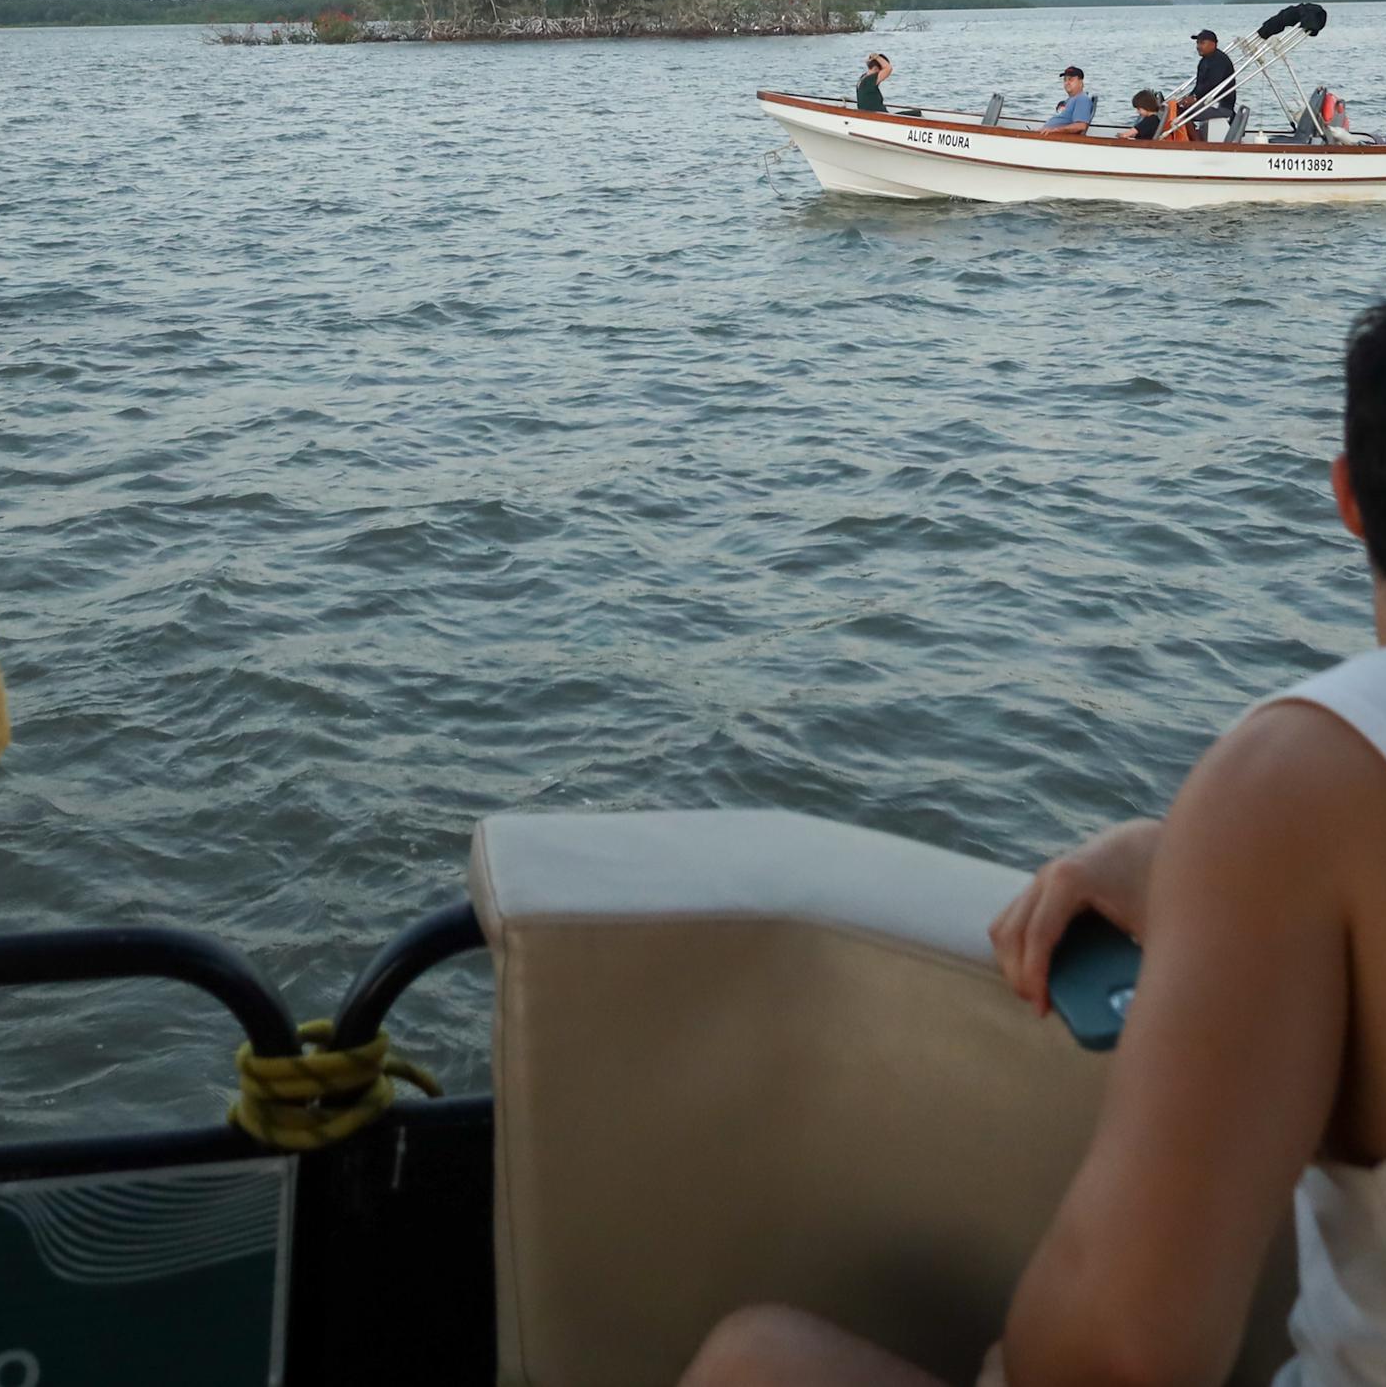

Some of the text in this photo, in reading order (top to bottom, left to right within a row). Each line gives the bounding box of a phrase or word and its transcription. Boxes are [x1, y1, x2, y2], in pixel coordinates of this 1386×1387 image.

[908, 130, 970, 148] ALICE MOURA
[1268, 158, 1333, 171] 1410113892
